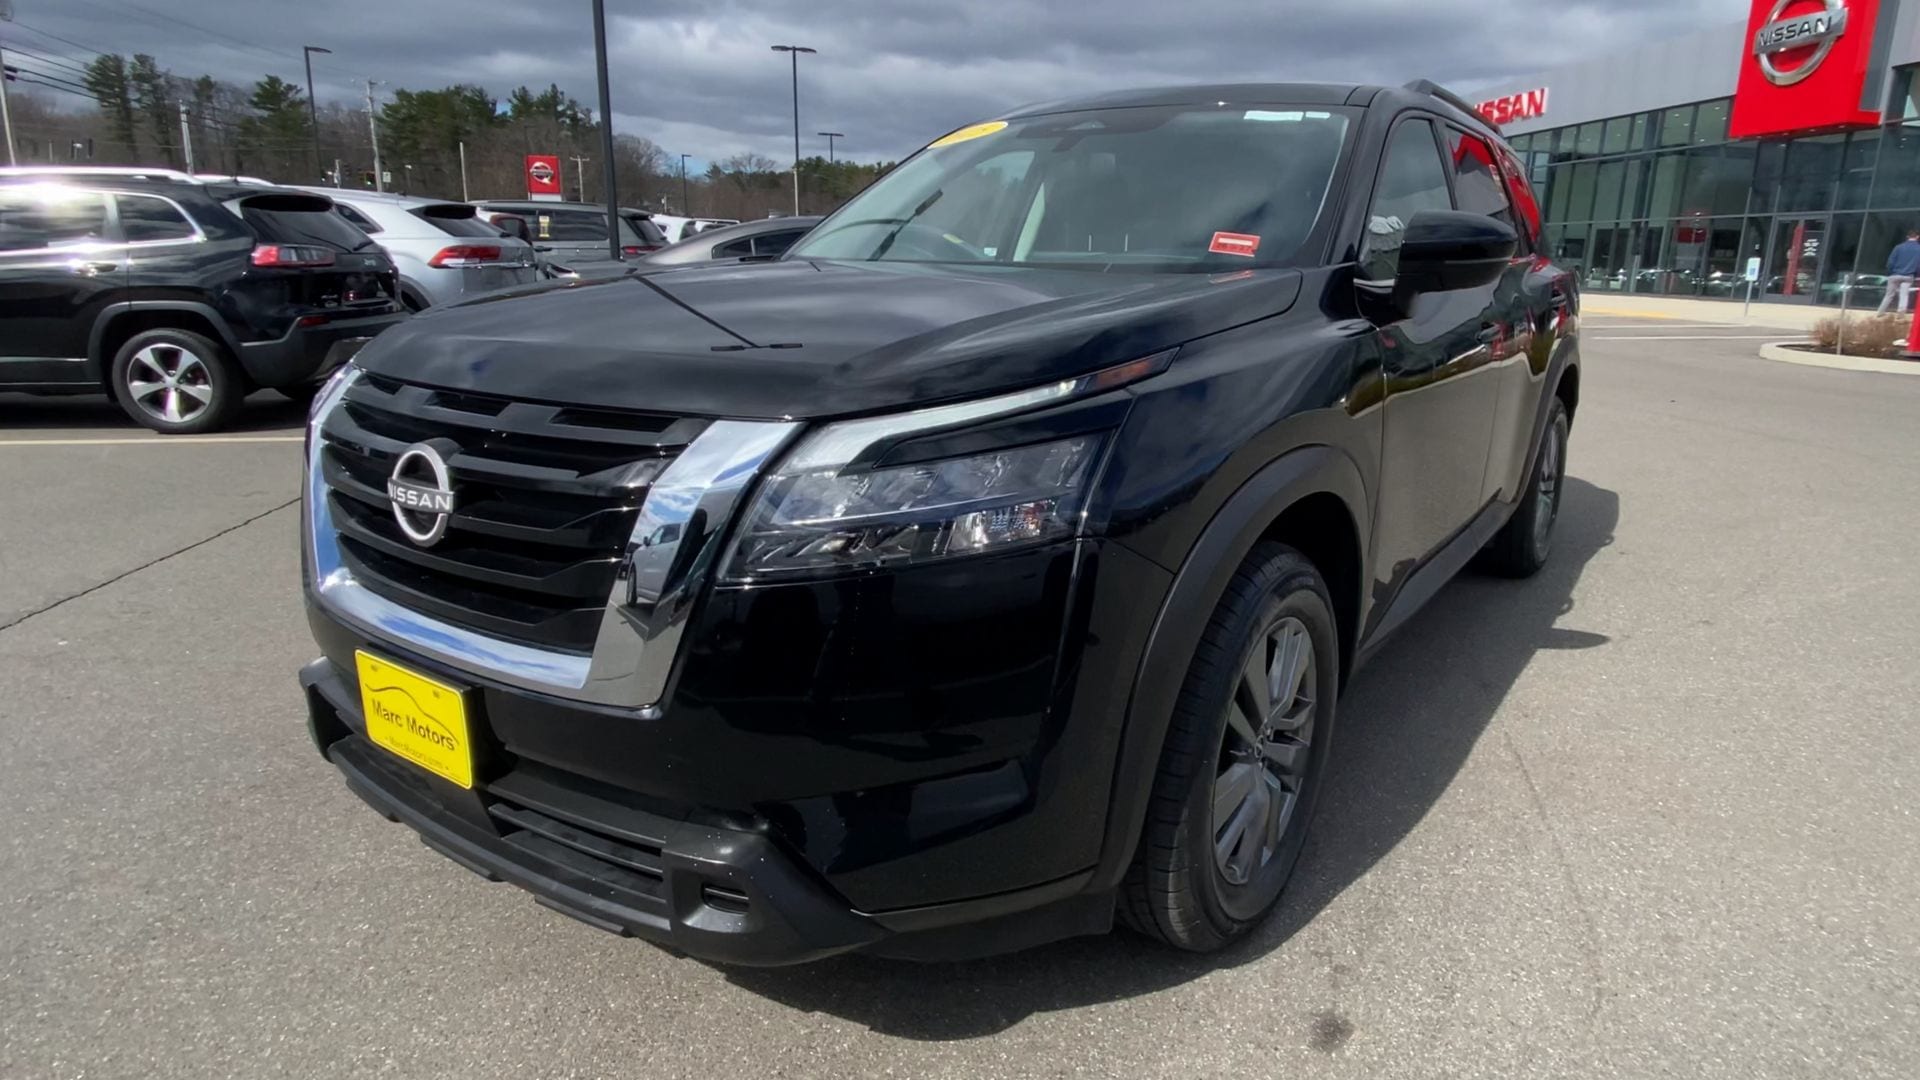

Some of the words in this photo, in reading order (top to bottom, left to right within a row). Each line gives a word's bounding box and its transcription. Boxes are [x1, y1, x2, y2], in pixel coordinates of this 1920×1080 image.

[1760, 16, 1832, 46] NISSAN
[387, 481, 450, 510] NISSAN
[371, 698, 403, 728] Marc
[406, 714, 455, 751] Motors
